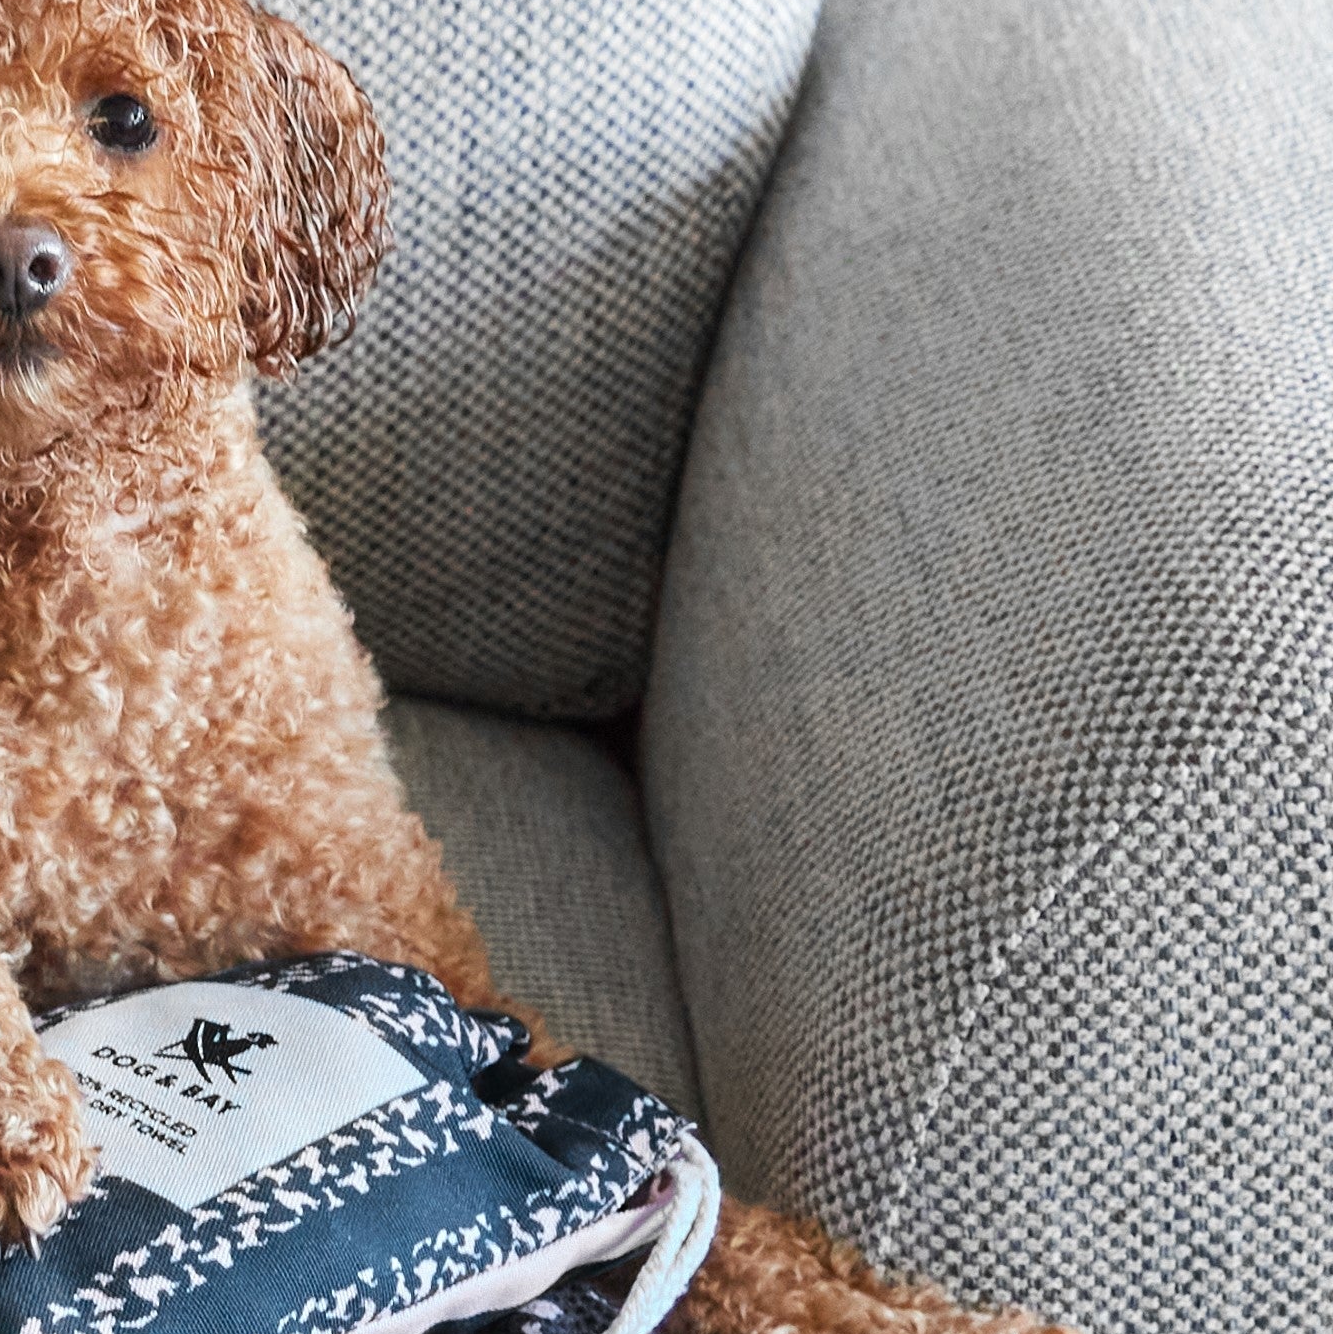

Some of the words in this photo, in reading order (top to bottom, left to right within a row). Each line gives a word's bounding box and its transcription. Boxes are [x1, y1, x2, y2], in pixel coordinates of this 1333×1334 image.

[92, 1047, 158, 1077] DOG
[155, 1074, 178, 1089] &
[180, 1084, 242, 1115] BAY
[90, 1099, 127, 1119] DRY
[130, 1119, 188, 1155] TOWEL
[105, 1089, 197, 1137] RECYCLED
